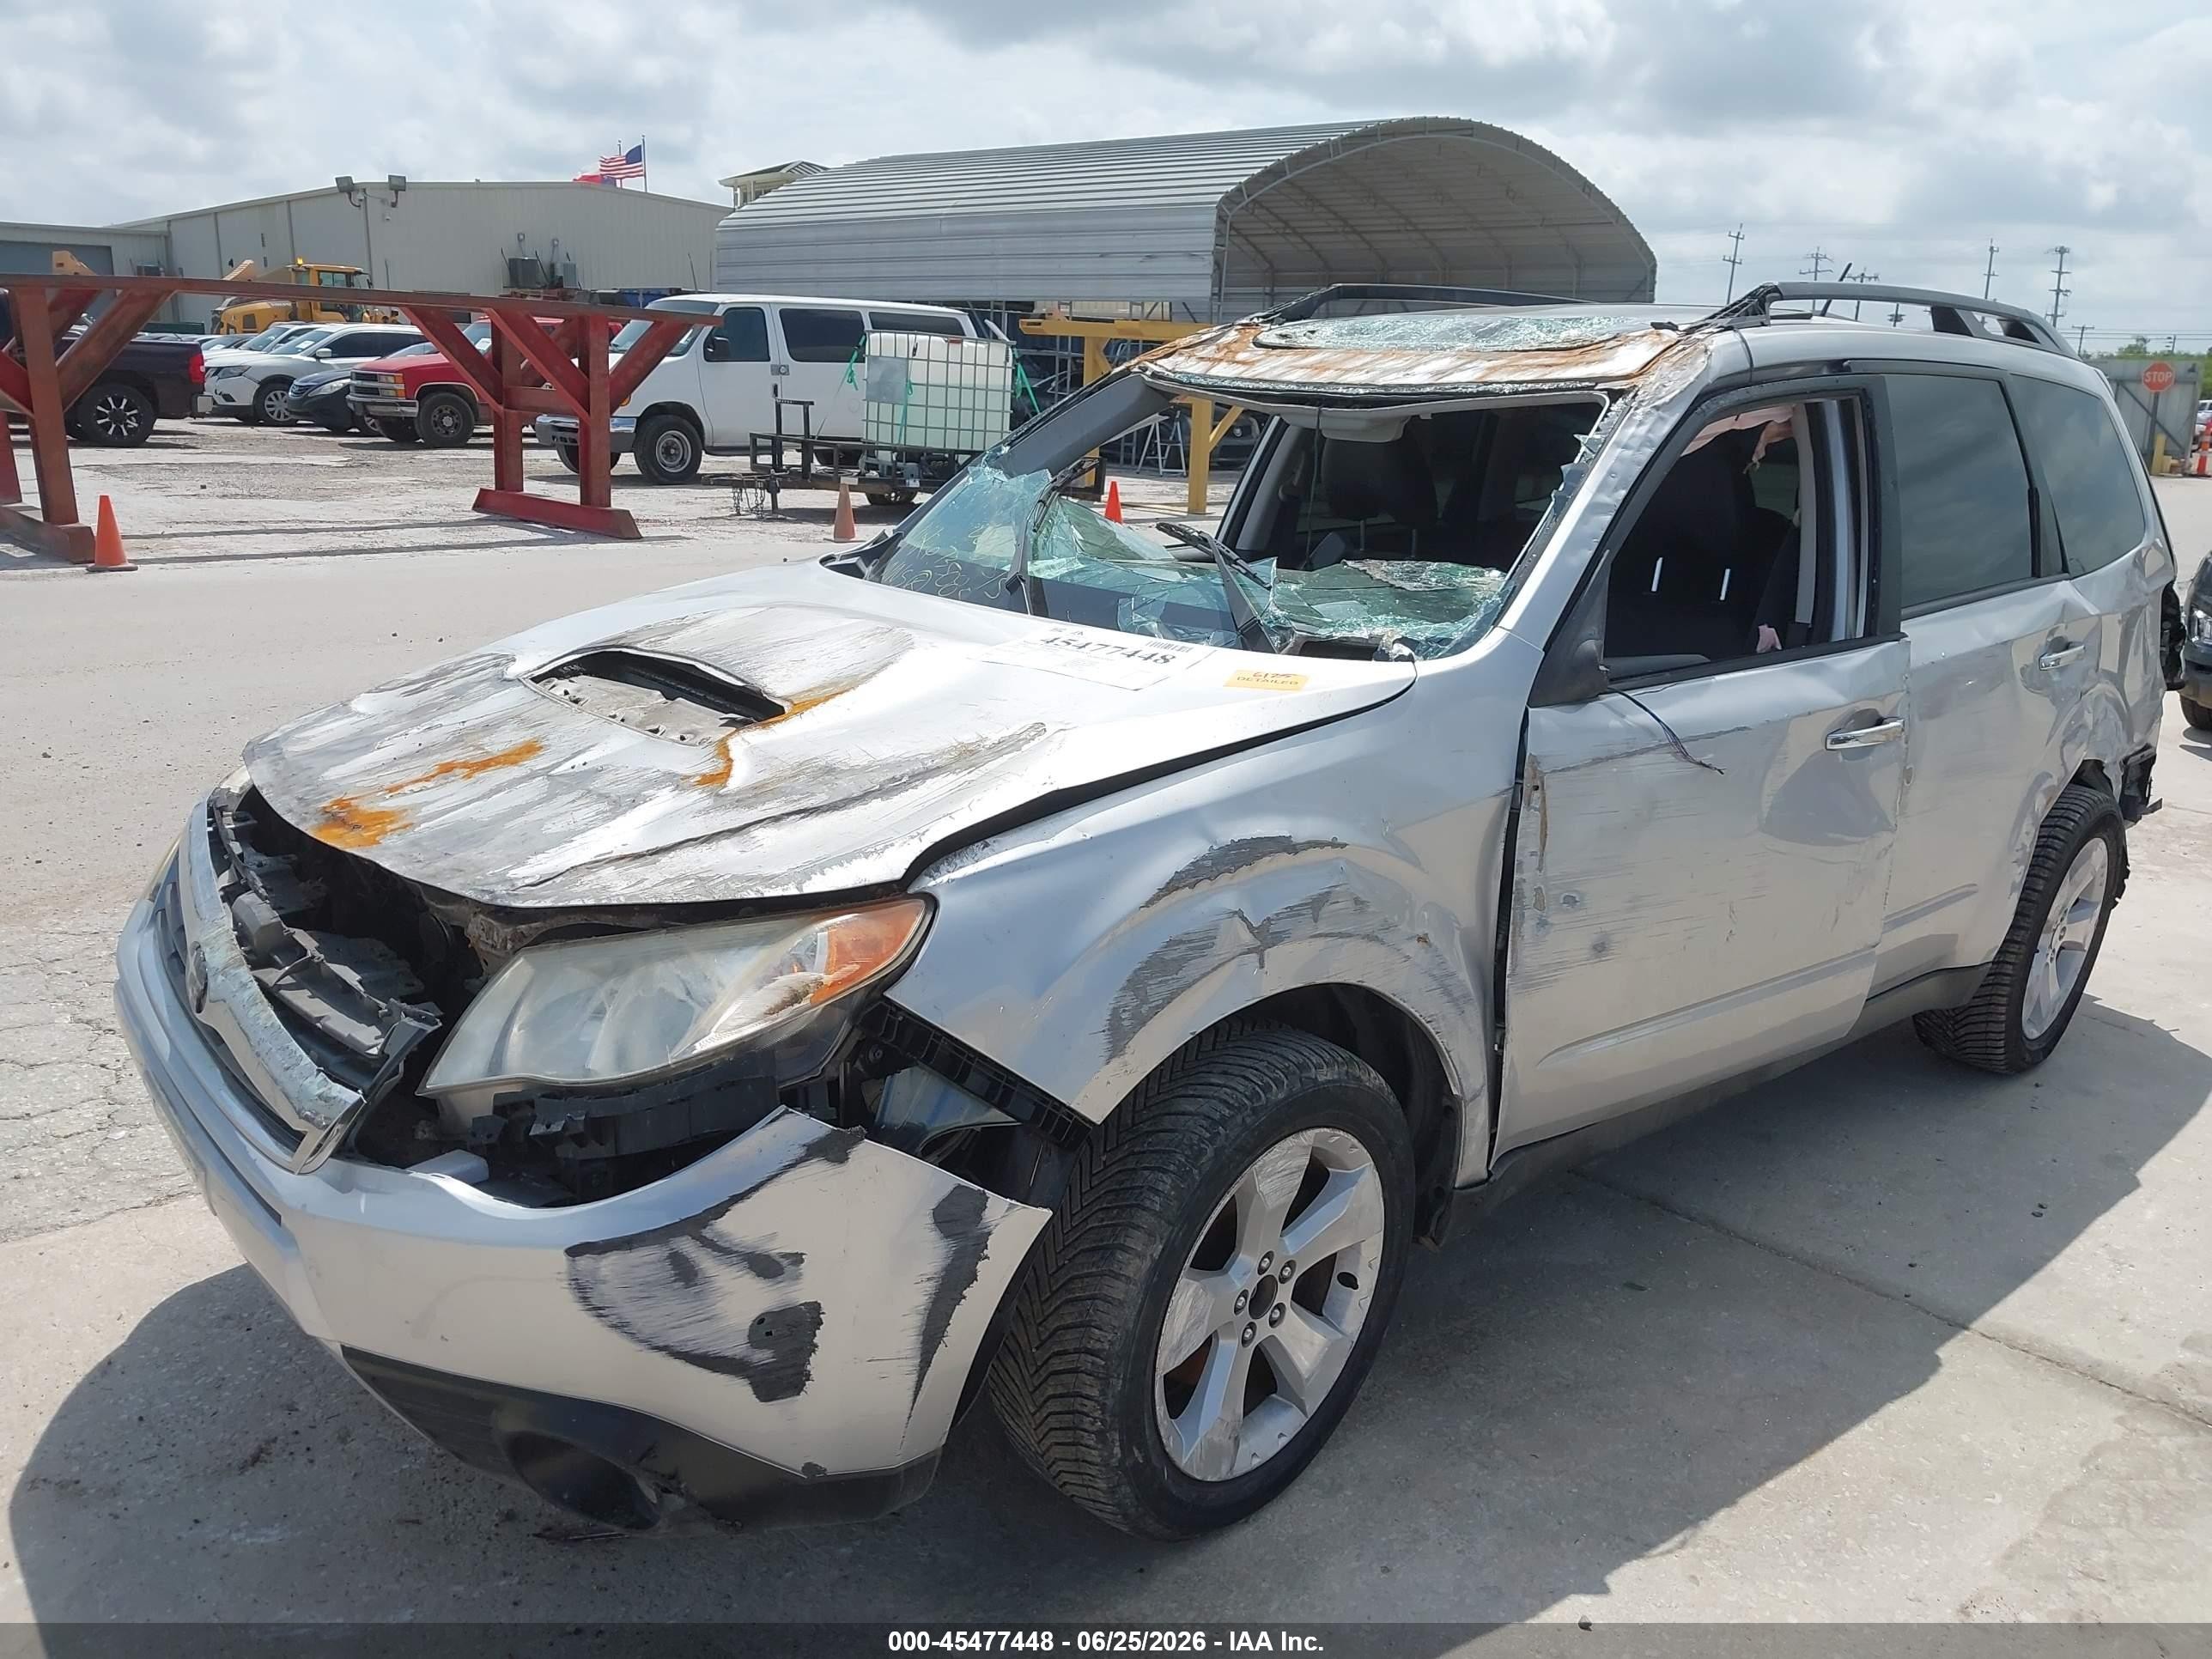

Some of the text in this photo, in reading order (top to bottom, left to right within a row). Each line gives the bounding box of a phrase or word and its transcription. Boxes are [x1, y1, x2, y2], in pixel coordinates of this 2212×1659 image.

[2144, 371, 2172, 384] STOP
[1039, 636, 1176, 665] 45477448
[1237, 676, 1299, 685] DETAILED
